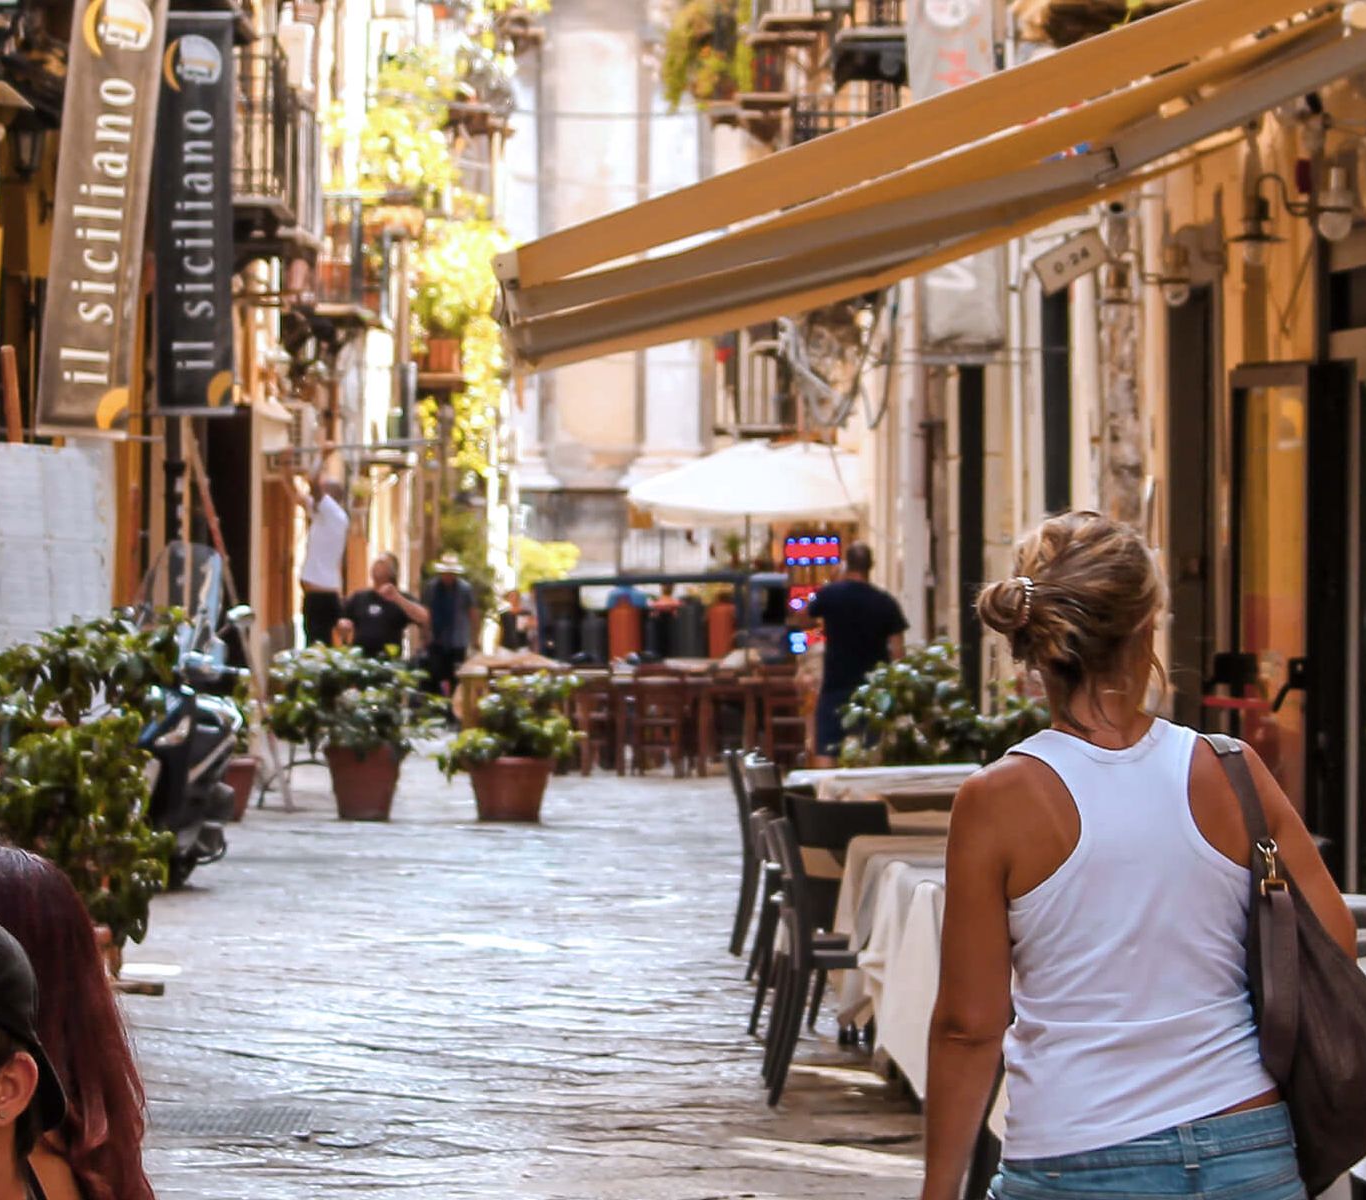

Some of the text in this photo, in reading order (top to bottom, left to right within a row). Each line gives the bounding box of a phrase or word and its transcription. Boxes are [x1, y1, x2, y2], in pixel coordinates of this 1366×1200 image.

[71, 77, 136, 325] siciliano
[171, 109, 214, 319] siciliano
[59, 347, 110, 384] il
[171, 341, 214, 369] il
